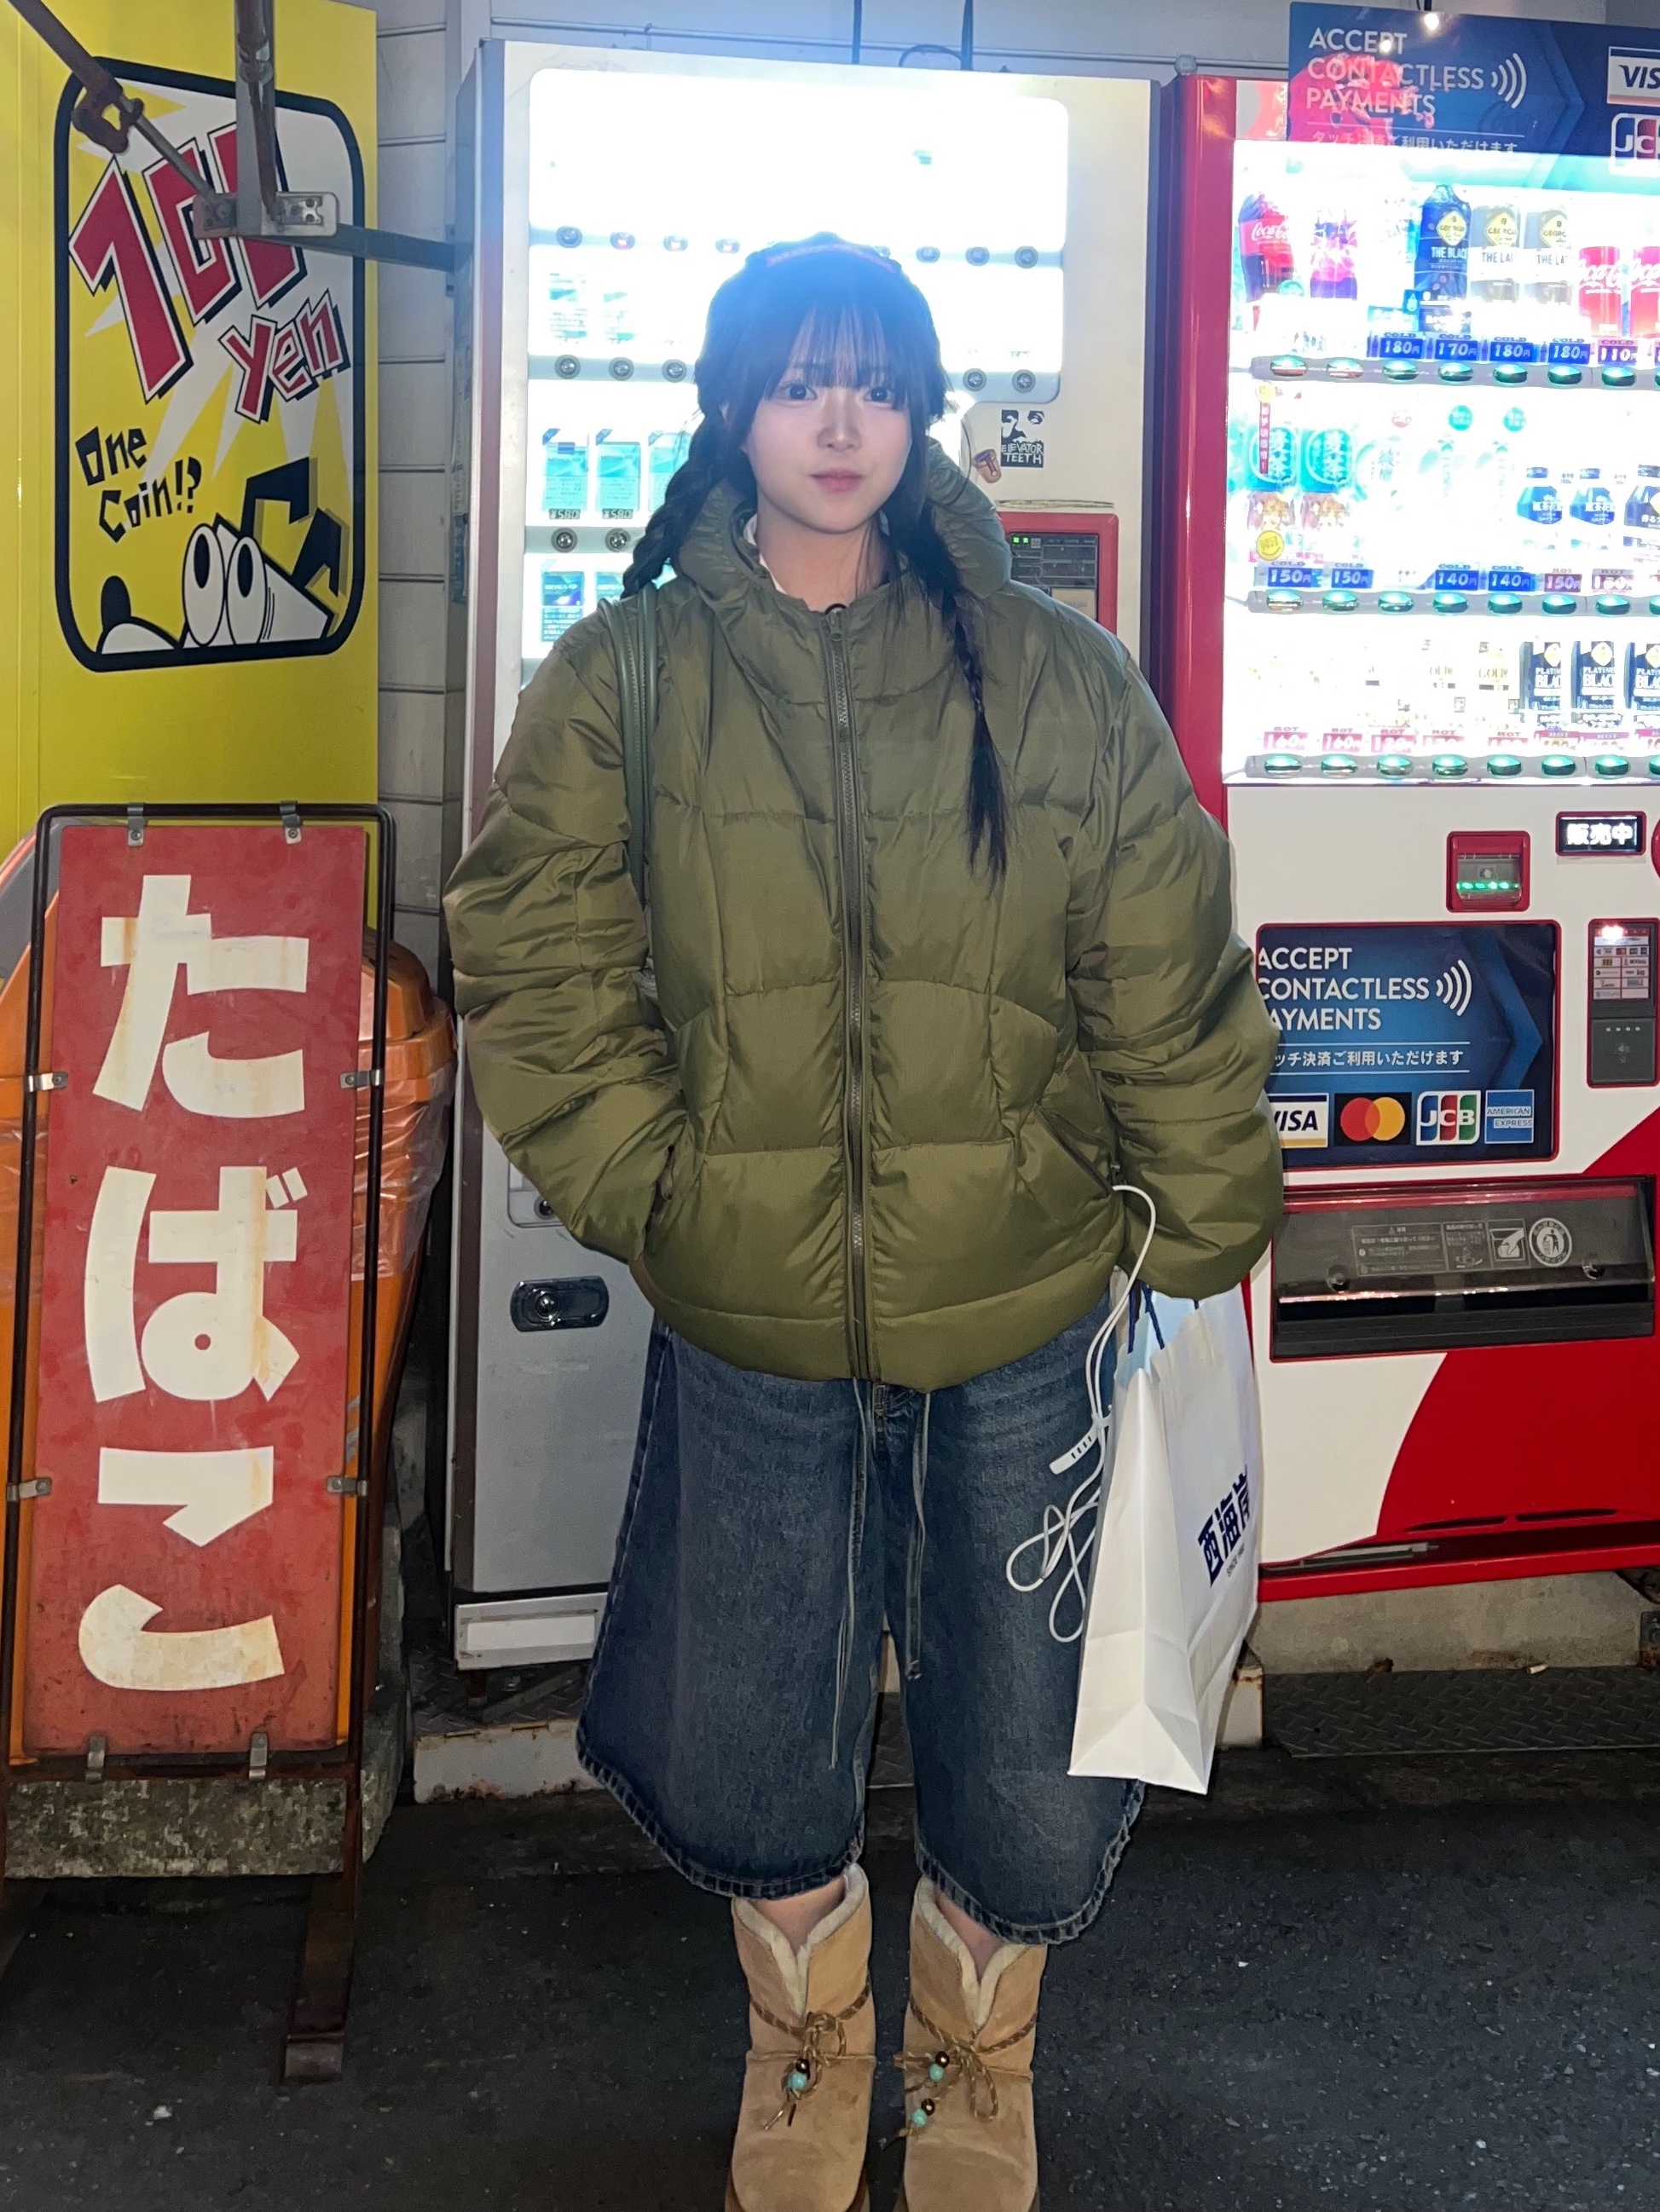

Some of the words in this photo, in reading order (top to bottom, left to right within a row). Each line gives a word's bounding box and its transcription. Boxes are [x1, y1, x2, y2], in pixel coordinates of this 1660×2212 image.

[1308, 26, 1408, 55] ACCEPT
[1307, 56, 1484, 90] CONTACTLESS
[1306, 86, 1437, 116] PAYMENTS
[1431, 245, 1447, 258] THE
[75, 425, 147, 487] One
[1001, 442, 1044, 455] ELEVATOR
[1003, 453, 1042, 465] TEETH
[99, 456, 202, 543] Coin!?
[1258, 947, 1353, 970] ACCEPT
[1258, 978, 1430, 1001] CONTACTLESS
[1270, 1008, 1382, 1031] AYMENTS
[1274, 1049, 1465, 1067] ッチ決済ご利用いただけます
[1420, 1108, 1475, 1128] JCB
[1486, 1106, 1531, 1117] AMERICAN
[1494, 1118, 1533, 1128] EXPRESS
[77, 874, 309, 1692] たばこ
